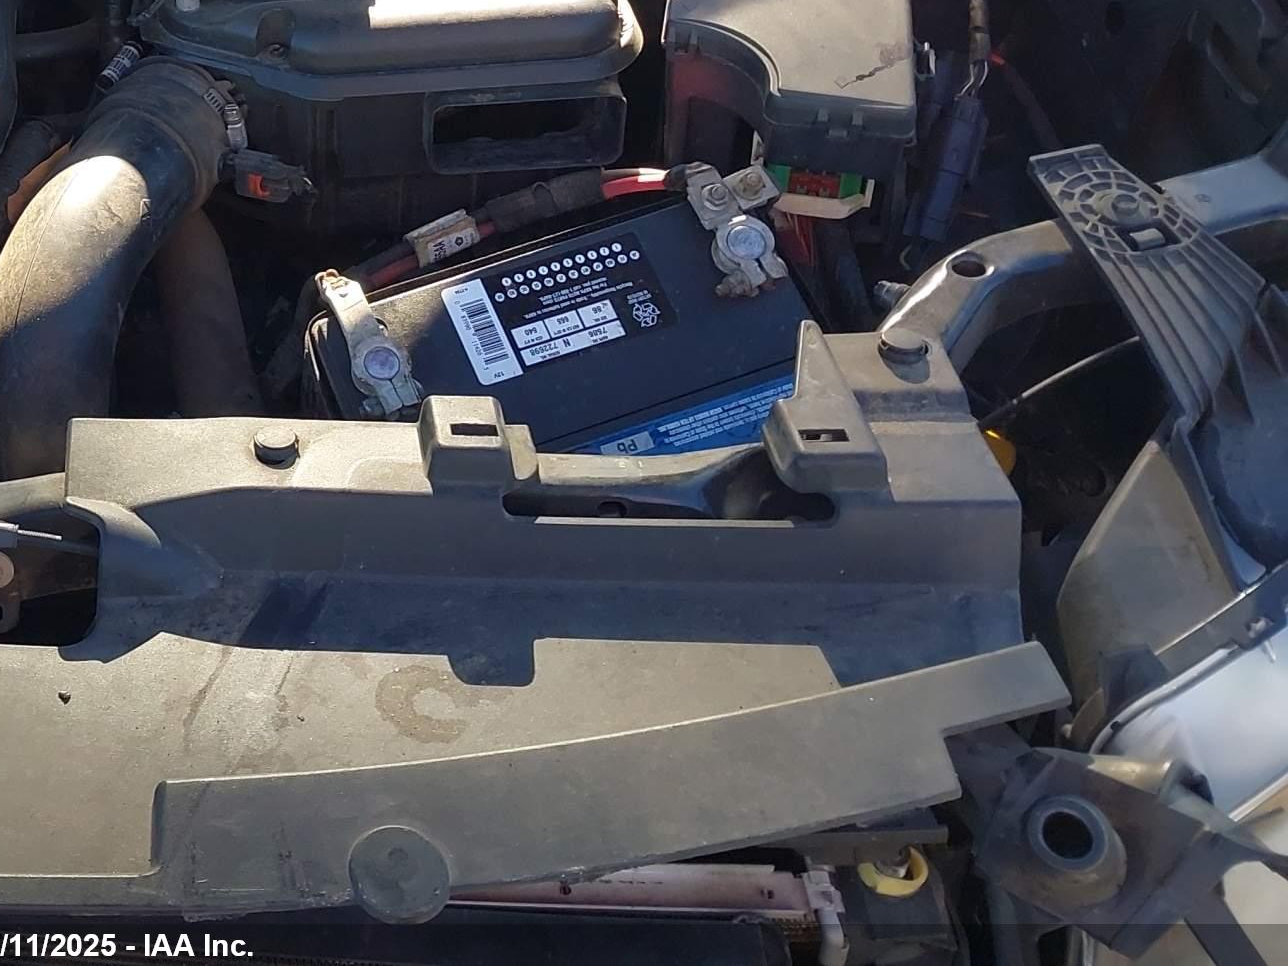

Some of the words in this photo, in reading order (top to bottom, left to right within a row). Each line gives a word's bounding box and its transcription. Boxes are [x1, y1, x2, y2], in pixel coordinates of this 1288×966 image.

[588, 326, 608, 338] 7586
[529, 341, 558, 356] 722698
[562, 338, 572, 348] N
[494, 370, 504, 378] 12V
[617, 438, 638, 454] Pb
